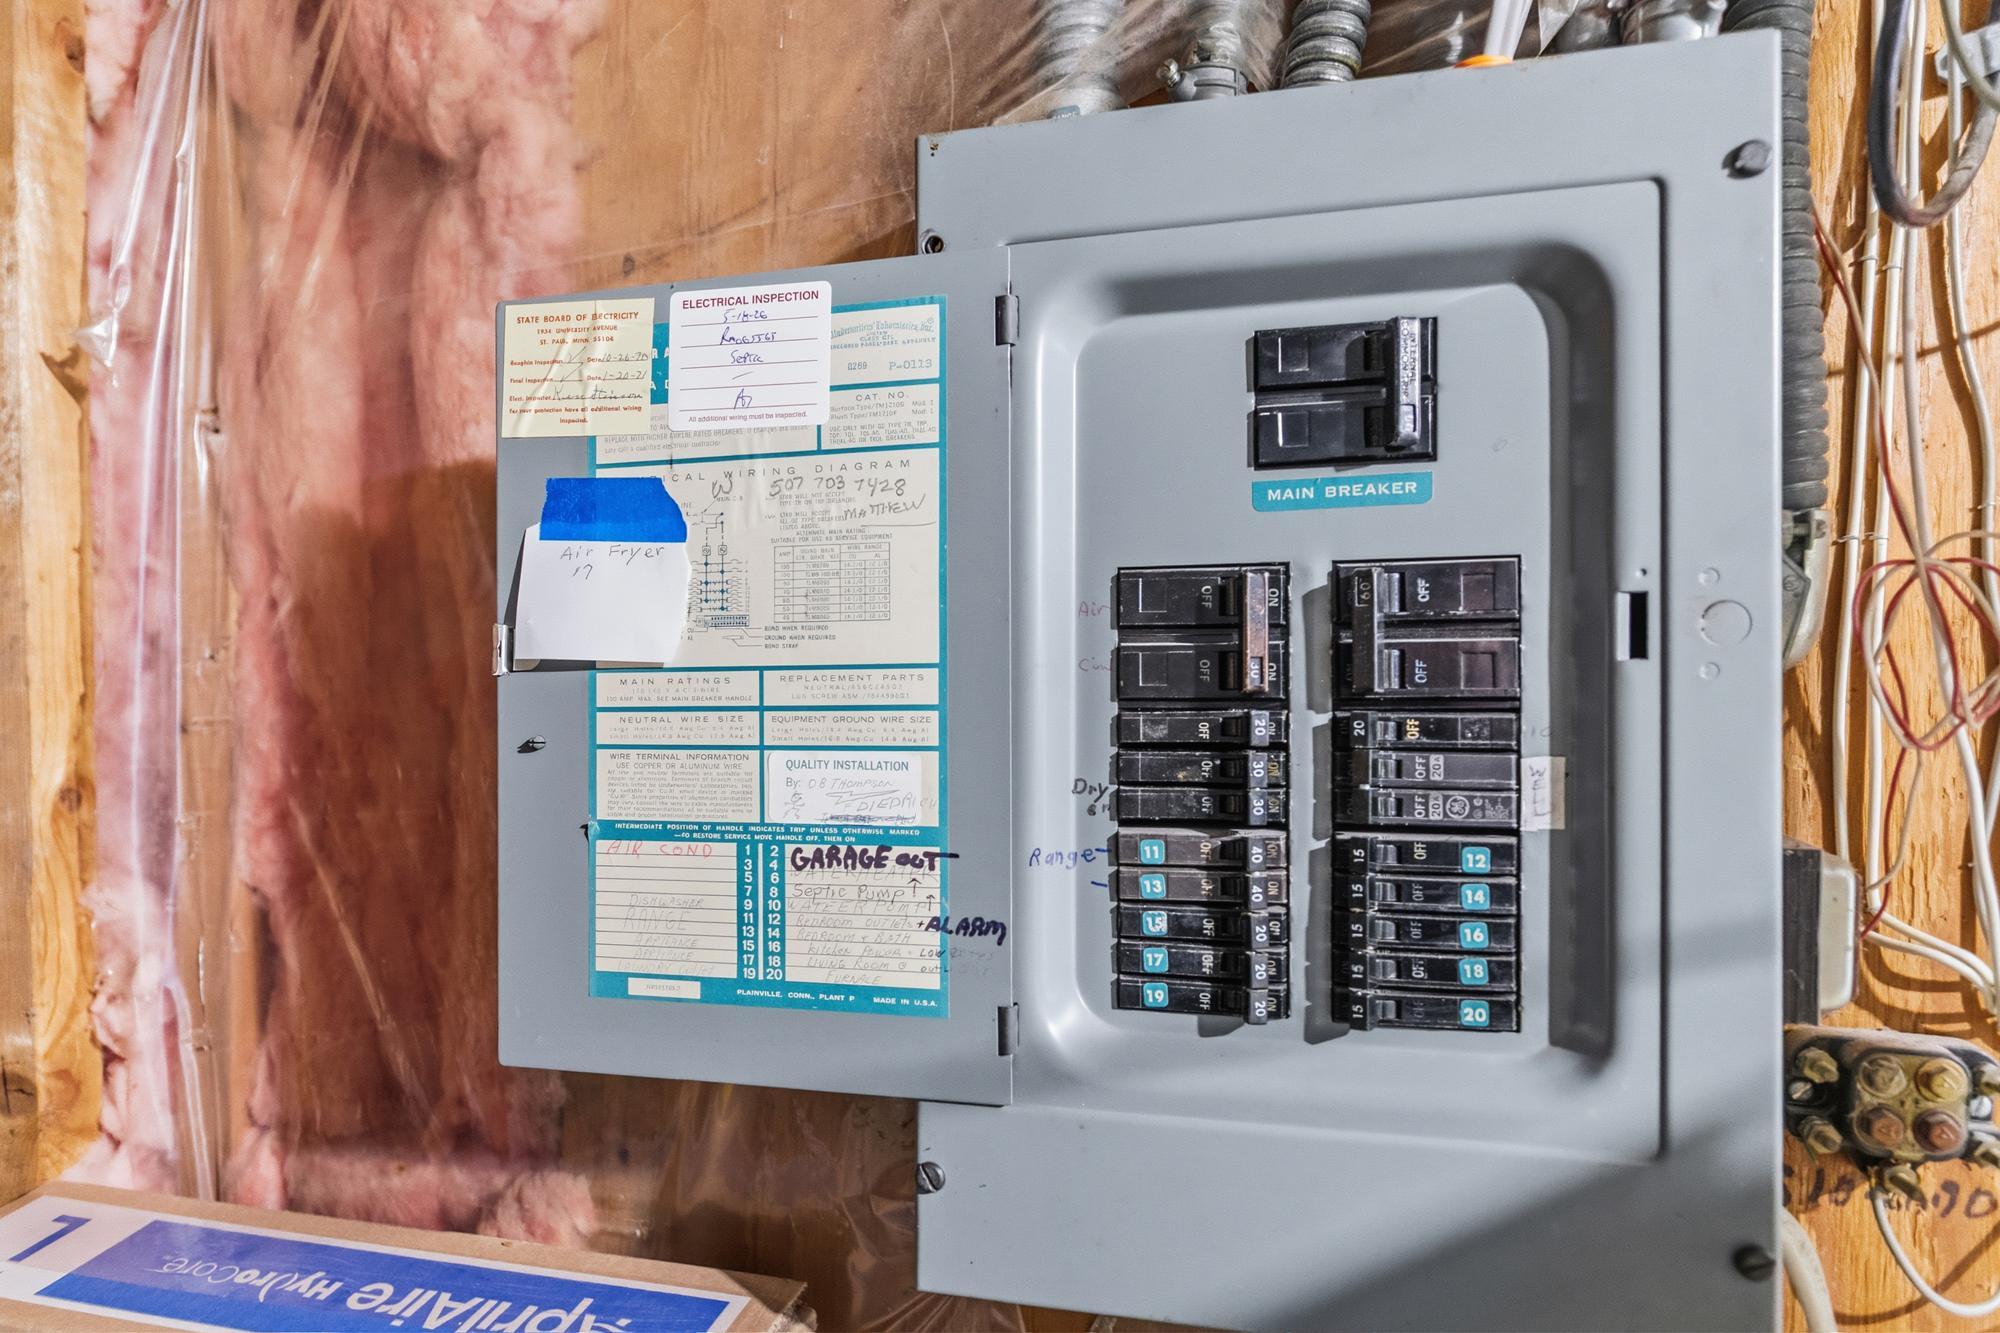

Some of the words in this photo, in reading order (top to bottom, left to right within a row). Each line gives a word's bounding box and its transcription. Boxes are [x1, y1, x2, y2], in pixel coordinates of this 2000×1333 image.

[682, 296, 749, 309] ELECTRICAL
[752, 290, 819, 304] INSPECTION
[517, 316, 540, 324] STATE
[544, 315, 572, 323] BOARD
[592, 312, 639, 321] ELECTRICITY
[855, 393, 881, 402] CAT.
[887, 391, 910, 399] NO.
[729, 414, 748, 422] wiring
[774, 411, 807, 420] inspected.
[723, 465, 796, 481] WIRING
[815, 459, 911, 474] DIAGRAM
[769, 476, 803, 497] 507
[815, 475, 846, 490] 703
[854, 478, 906, 497] 7428
[1267, 487, 1314, 501] MAIN
[1324, 481, 1417, 498] BREAKER
[560, 545, 593, 560] Air
[608, 544, 665, 566] Fryer
[1360, 582, 1371, 600] 60
[1417, 577, 1430, 602] OFF
[1201, 585, 1213, 609] OFF
[1200, 659, 1211, 682] OFF
[1415, 659, 1427, 683] OFF
[619, 678, 655, 686] MAIN
[667, 677, 732, 685] RATINGS
[780, 674, 873, 683] REPLACEMENT
[882, 673, 925, 681] PARTS
[619, 717, 672, 725] NEUTRAL
[717, 715, 745, 723] SIZE
[771, 715, 826, 724] EQUIPMENT
[832, 715, 875, 724] GROUND
[880, 715, 905, 724] WIRE
[910, 716, 932, 724] SIZE
[1198, 721, 1210, 740] OFF
[1254, 718, 1266, 737] 20
[1353, 720, 1365, 736] 20
[1407, 718, 1420, 740] OFF
[636, 753, 681, 761] TERMINAL
[686, 753, 750, 761] INFORMATION
[665, 762, 676, 770] OR
[679, 762, 720, 770] ALUMINUM
[723, 762, 743, 770] WIRE
[785, 759, 830, 771] QUALITY
[833, 760, 909, 772] INSTALLATION
[1252, 760, 1265, 778] 30
[1415, 755, 1426, 779] OFF
[1432, 757, 1443, 779] 20A
[786, 777, 801, 790] By:
[1072, 778, 1109, 803] Dry
[1252, 798, 1265, 816] 30
[1414, 794, 1426, 818] OFF
[1431, 795, 1442, 818] 20A
[745, 845, 751, 856] 1
[769, 846, 779, 857] 2
[1143, 846, 1160, 859] 11
[1251, 846, 1264, 864] 40
[1353, 848, 1365, 862] 15
[744, 859, 752, 871] 3
[790, 844, 893, 872] GARAGE
[895, 851, 960, 872] OUT
[1029, 847, 1096, 869] Range
[1467, 853, 1486, 868] 12
[769, 860, 779, 871] 4
[744, 872, 753, 883] 5
[770, 872, 780, 884] 6
[744, 886, 752, 897] 7
[769, 887, 779, 898] 8
[1143, 879, 1162, 893] 13
[1352, 883, 1364, 896] 15
[1412, 882, 1424, 901] OFF
[792, 884, 848, 904] Septic
[858, 885, 905, 904] Pump
[1251, 885, 1263, 903] 40
[1465, 889, 1485, 904] 14
[744, 900, 753, 911] 9
[767, 901, 781, 912] 10
[623, 908, 691, 931] RANGE
[744, 913, 753, 924] 11
[768, 914, 781, 925] 12
[1146, 917, 1166, 931] 15
[742, 926, 755, 938] 13
[767, 928, 781, 939] 14
[1203, 918, 1215, 937] OFF
[1255, 925, 1268, 943] 20
[1352, 922, 1364, 938] 15
[1464, 928, 1484, 943] 16
[742, 940, 755, 951] 15
[768, 941, 781, 953] 16
[743, 954, 755, 966] 17
[768, 956, 781, 968] 18
[1146, 954, 1163, 967] 17
[743, 968, 756, 980] 19
[766, 969, 783, 981] 20
[1255, 963, 1266, 980] 20
[1352, 963, 1364, 977] 15
[1464, 964, 1484, 978] 18
[819, 993, 845, 1001] PLANT
[873, 997, 896, 1005] MADE
[901, 998, 910, 1006] IN
[914, 999, 938, 1007] U.S.A.
[1146, 989, 1164, 1003] 19
[1199, 992, 1212, 1011] OFF
[1254, 1000, 1266, 1018] 20
[1352, 1005, 1364, 1019] 15
[1464, 1007, 1486, 1022] 20
